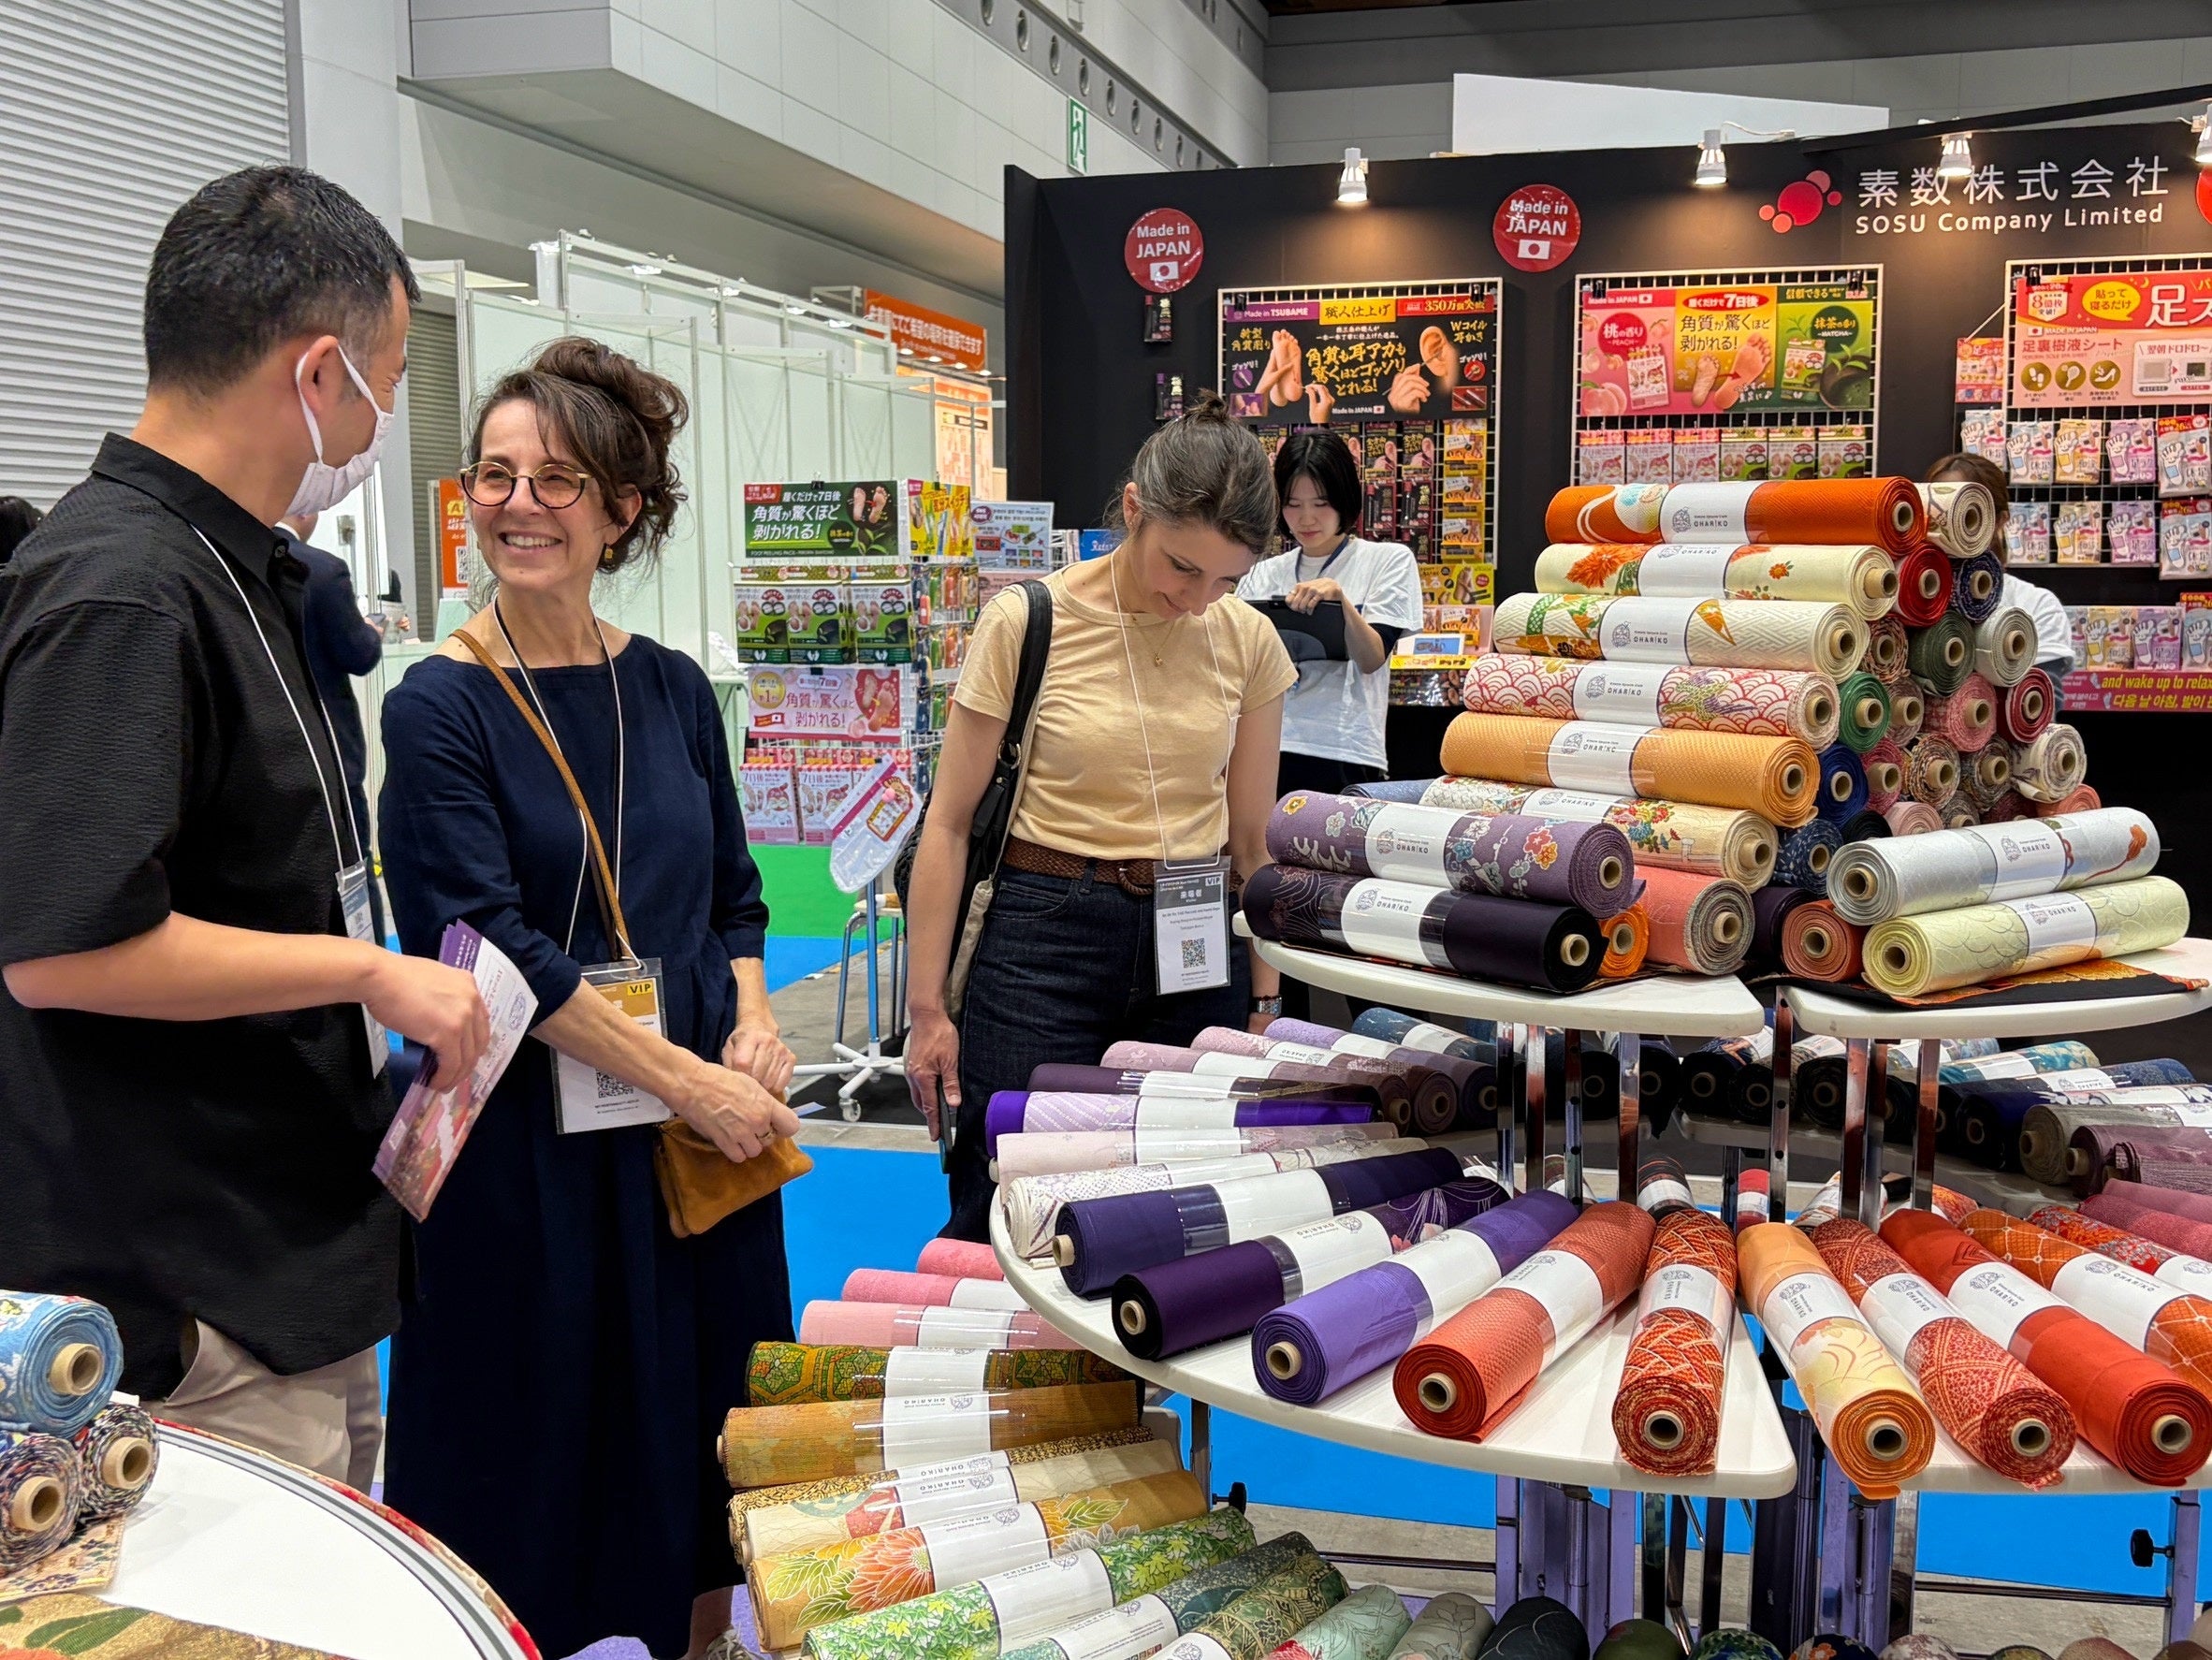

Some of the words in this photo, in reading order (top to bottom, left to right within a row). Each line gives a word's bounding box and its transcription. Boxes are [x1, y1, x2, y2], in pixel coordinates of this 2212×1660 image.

[1858, 155, 2169, 209] 素数株式会社
[1510, 199, 1551, 214] Made
[1554, 199, 1568, 214] in
[1506, 217, 1566, 236] JAPAN
[1855, 214, 1926, 234] SOSU
[1938, 211, 2053, 235] Company
[2064, 203, 2163, 226] Limited
[1137, 225, 1173, 238] Made
[1176, 223, 1190, 236] in
[1135, 240, 1191, 258] JAPAN
[2096, 289, 2127, 299] 貼って
[1324, 303, 1391, 319] 職人仕上げ
[2090, 300, 2132, 311] 寝るだけ
[1681, 313, 1770, 333] 角質が驚くほど
[2022, 338, 2123, 353] 足裏樹液シート
[1305, 341, 1406, 368] 角質も耳アカも
[1335, 378, 1378, 397] とれる!
[751, 504, 841, 522] 角質が驚くほど
[752, 523, 822, 541] 剥がれる!
[2102, 674, 2123, 689] and
[2125, 674, 2153, 689] wake
[2157, 677, 2170, 692] up
[2173, 675, 2184, 689] to
[2186, 674, 2212, 689] relax
[1608, 687, 1642, 696] OHARIKO
[2113, 694, 2137, 708] 다음
[1396, 843, 1429, 853] OHARIKO
[1206, 876, 1221, 886] VIP
[1376, 901, 1409, 912] OHARIKO
[630, 983, 651, 994] VIP
[920, 1463, 965, 1477] OHARIKO
[920, 1479, 965, 1491] OHARIKO
